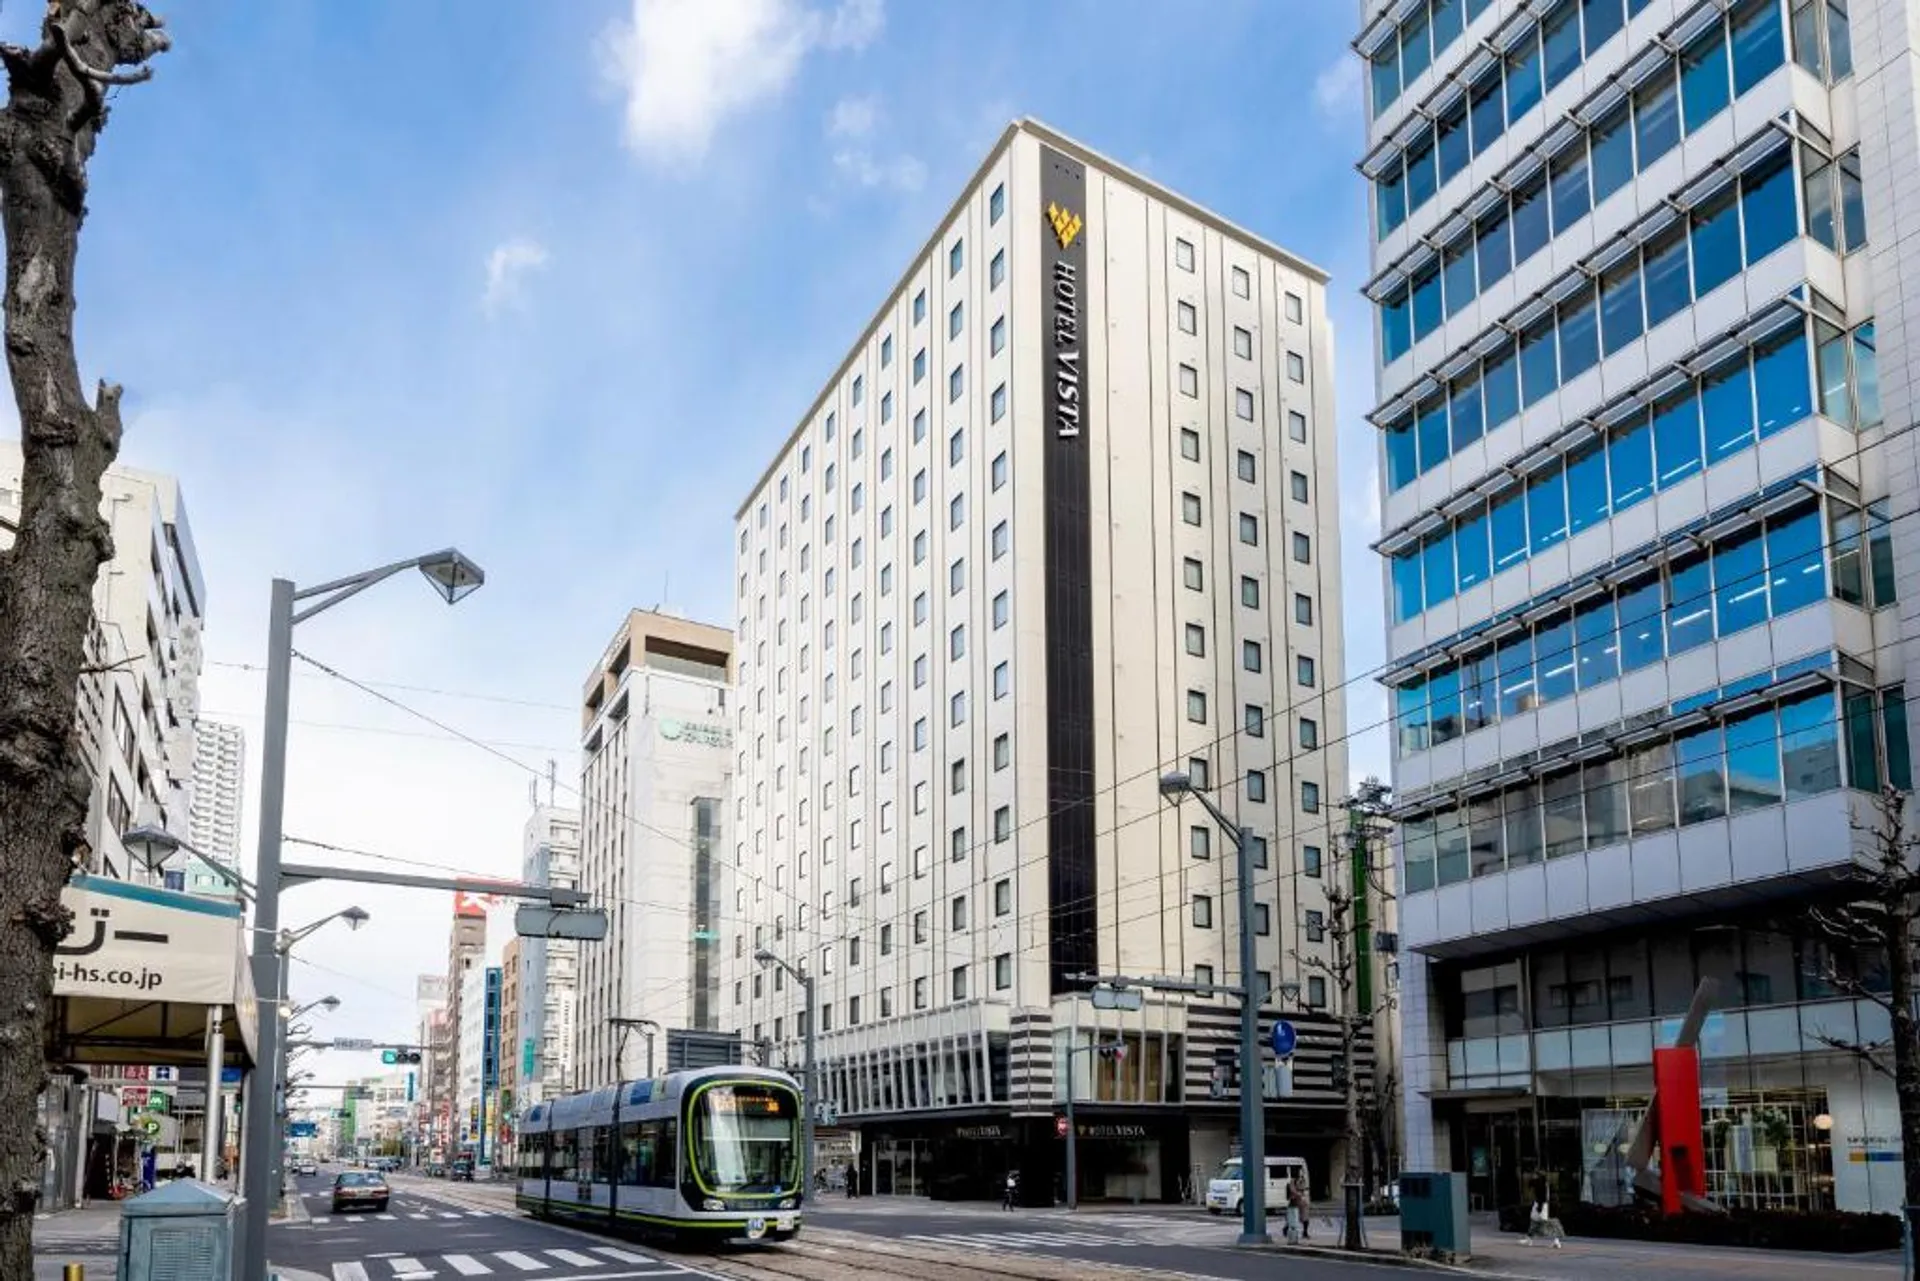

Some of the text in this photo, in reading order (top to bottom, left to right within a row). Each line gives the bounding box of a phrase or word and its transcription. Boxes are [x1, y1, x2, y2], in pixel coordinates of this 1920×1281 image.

[1056, 260, 1080, 438] HOTEL VISTA
[53, 961, 162, 990] i-hs.co.jp
